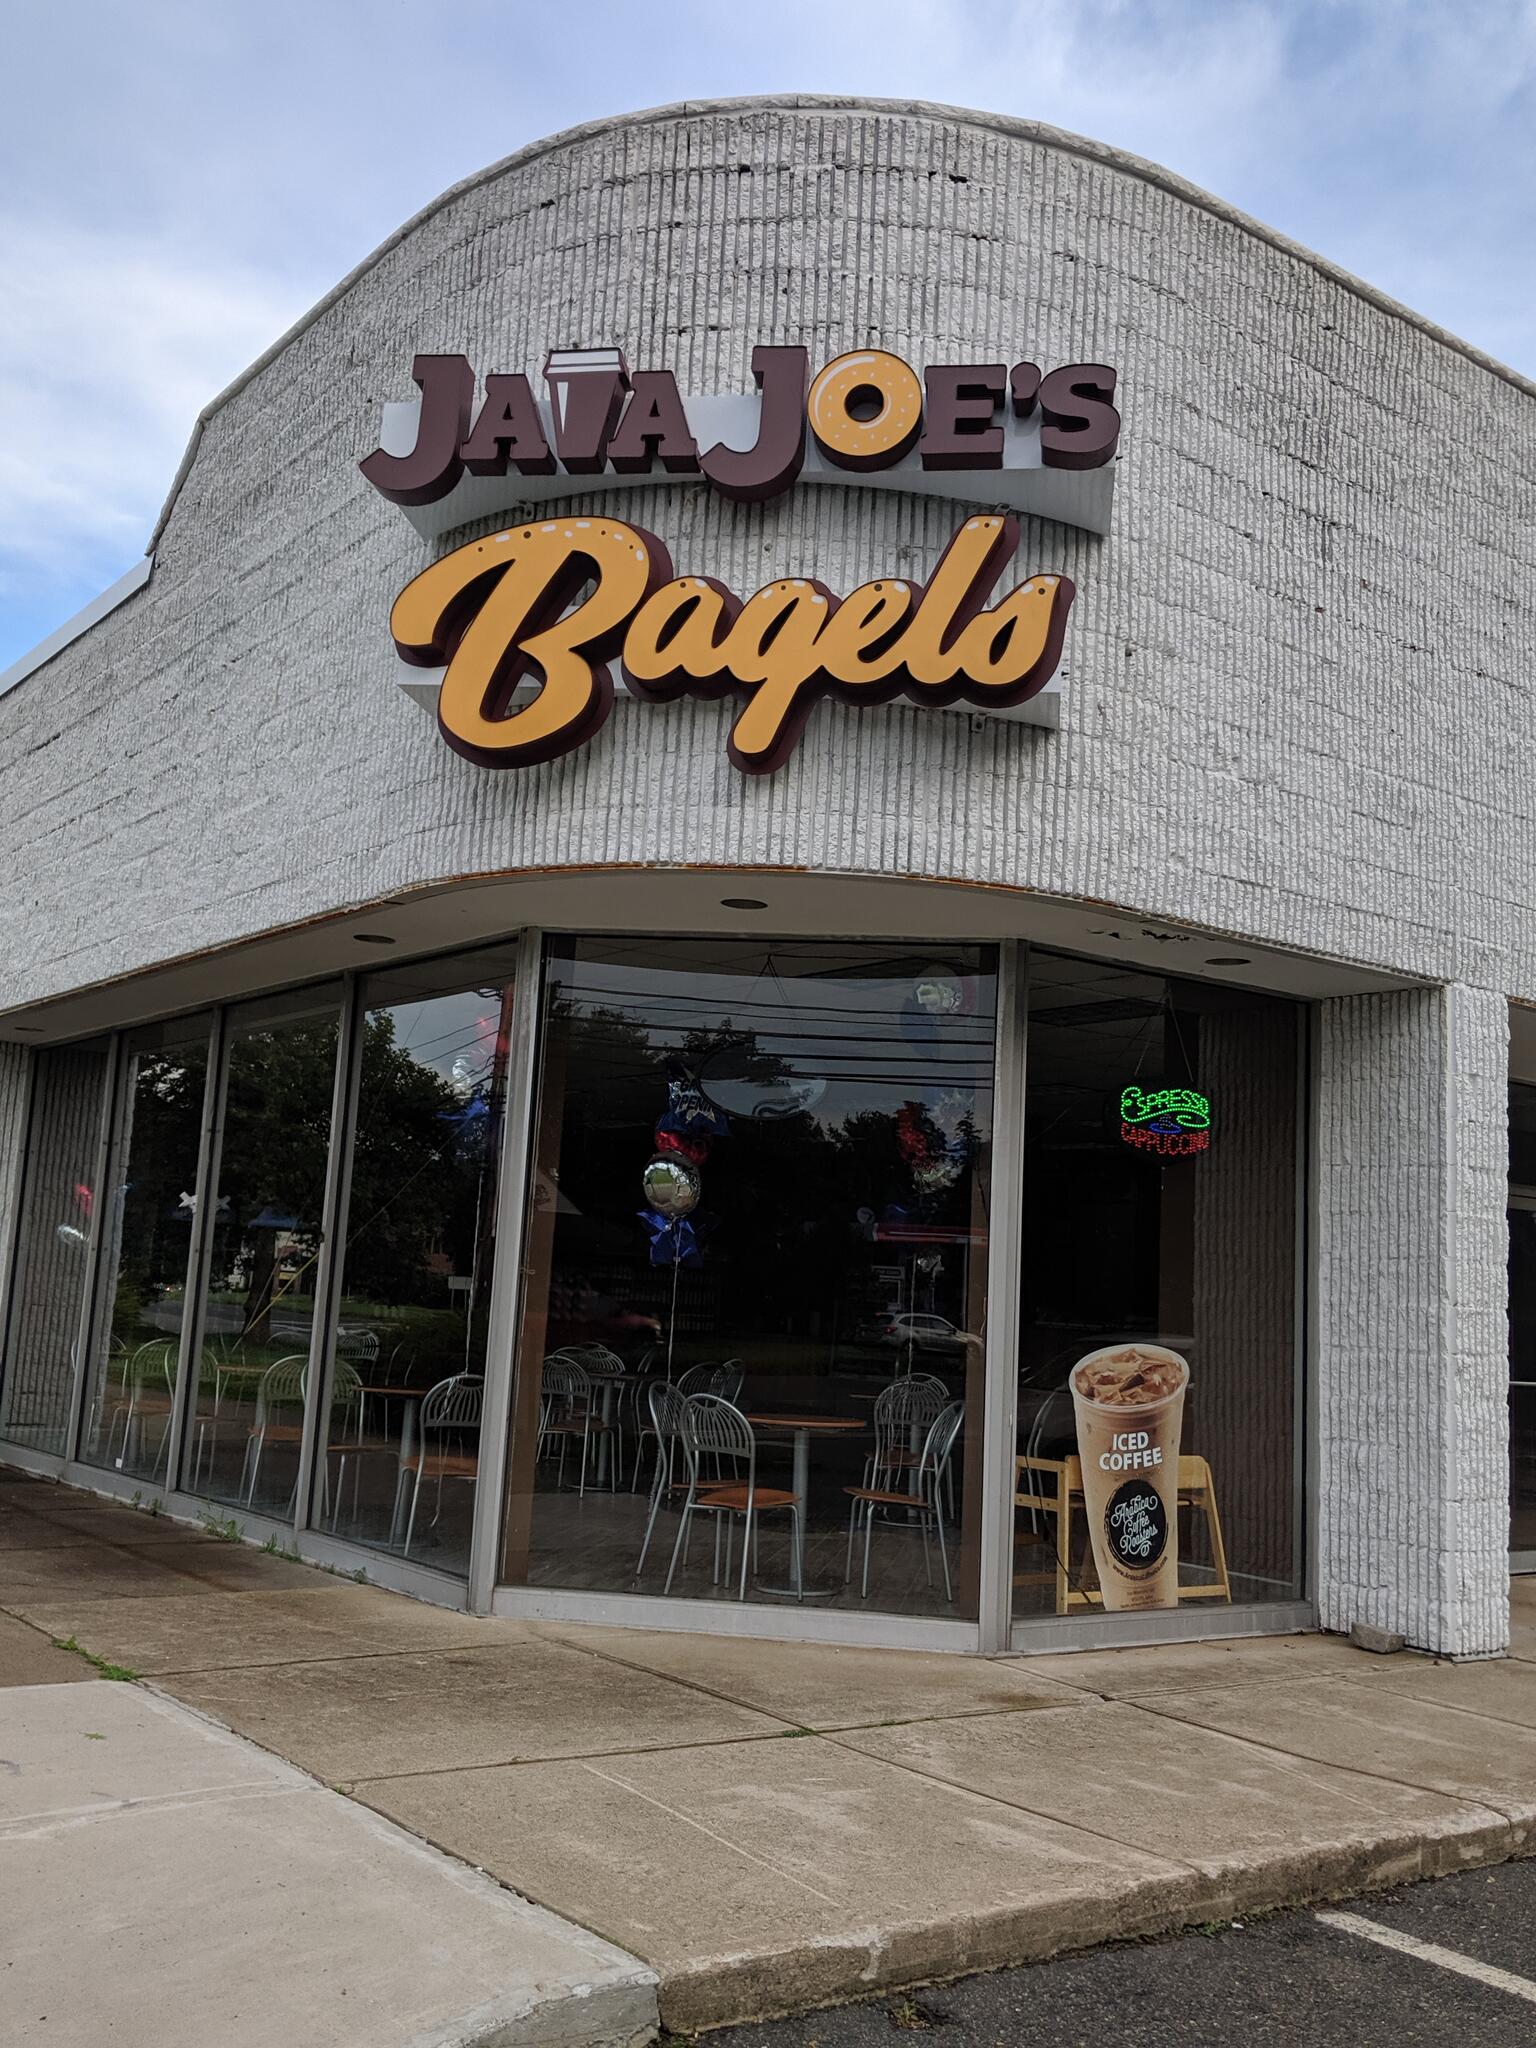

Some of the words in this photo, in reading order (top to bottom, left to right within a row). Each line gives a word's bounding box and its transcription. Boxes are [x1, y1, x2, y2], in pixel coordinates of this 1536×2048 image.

[360, 346, 700, 506] JAVA
[699, 345, 1121, 504] JOE'S
[390, 514, 1076, 775] Bagels
[1112, 1431, 1149, 1451] ICED
[1099, 1446, 1163, 1471] COFFEE
[1111, 1495, 1158, 1527] Arabica
[1124, 1511, 1150, 1536] Coffee
[1120, 1524, 1159, 1557] Roasters
